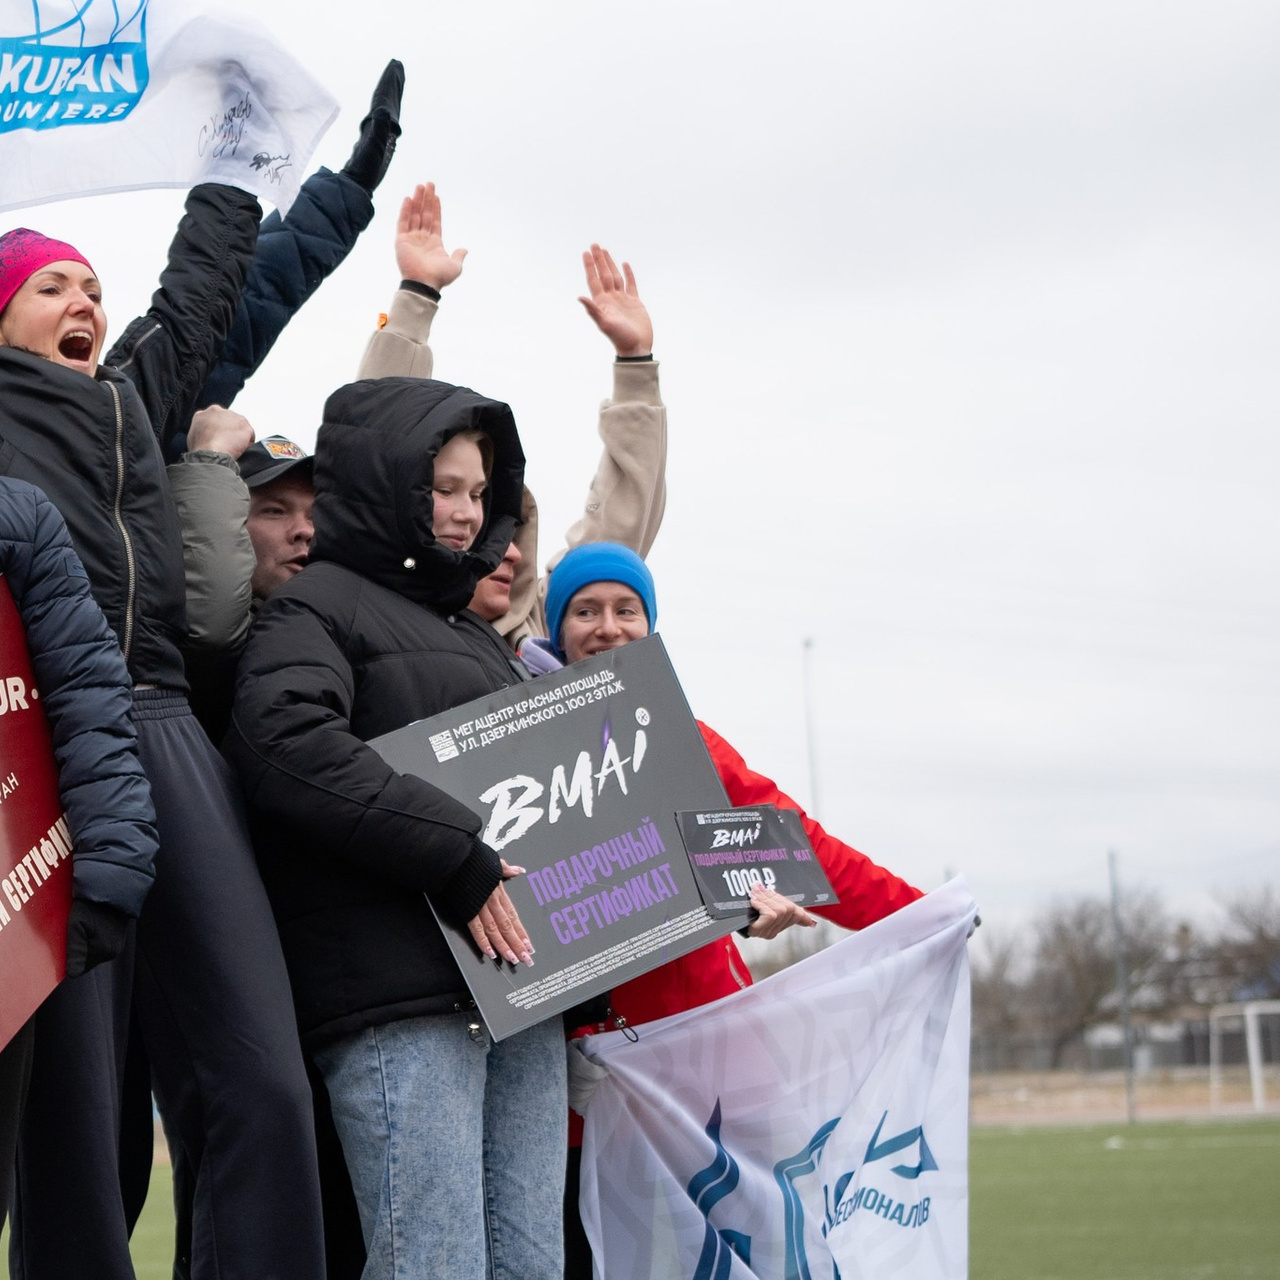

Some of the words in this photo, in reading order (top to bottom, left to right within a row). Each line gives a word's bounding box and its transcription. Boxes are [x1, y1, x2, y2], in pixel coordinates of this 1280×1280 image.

[452, 706, 514, 739] МЕГАЦЕНТР
[513, 688, 563, 714] КРАСНАЯ
[561, 670, 616, 699] ПЛОЩАДЬ
[458, 737, 480, 753] УЛ.
[480, 703, 568, 747] ДЗЕРЖИНСКОГО,
[566, 694, 588, 714] 100
[586, 691, 596, 704] 2
[594, 680, 625, 701] ЭТАЖ
[526, 819, 666, 907] ПОДАРОЧНЫЙ
[694, 849, 744, 866] ПОДАРОЧНЫЙ
[743, 848, 788, 863] СЕРТИФИКАТ
[549, 864, 680, 946] СЕРТИФИКАТ
